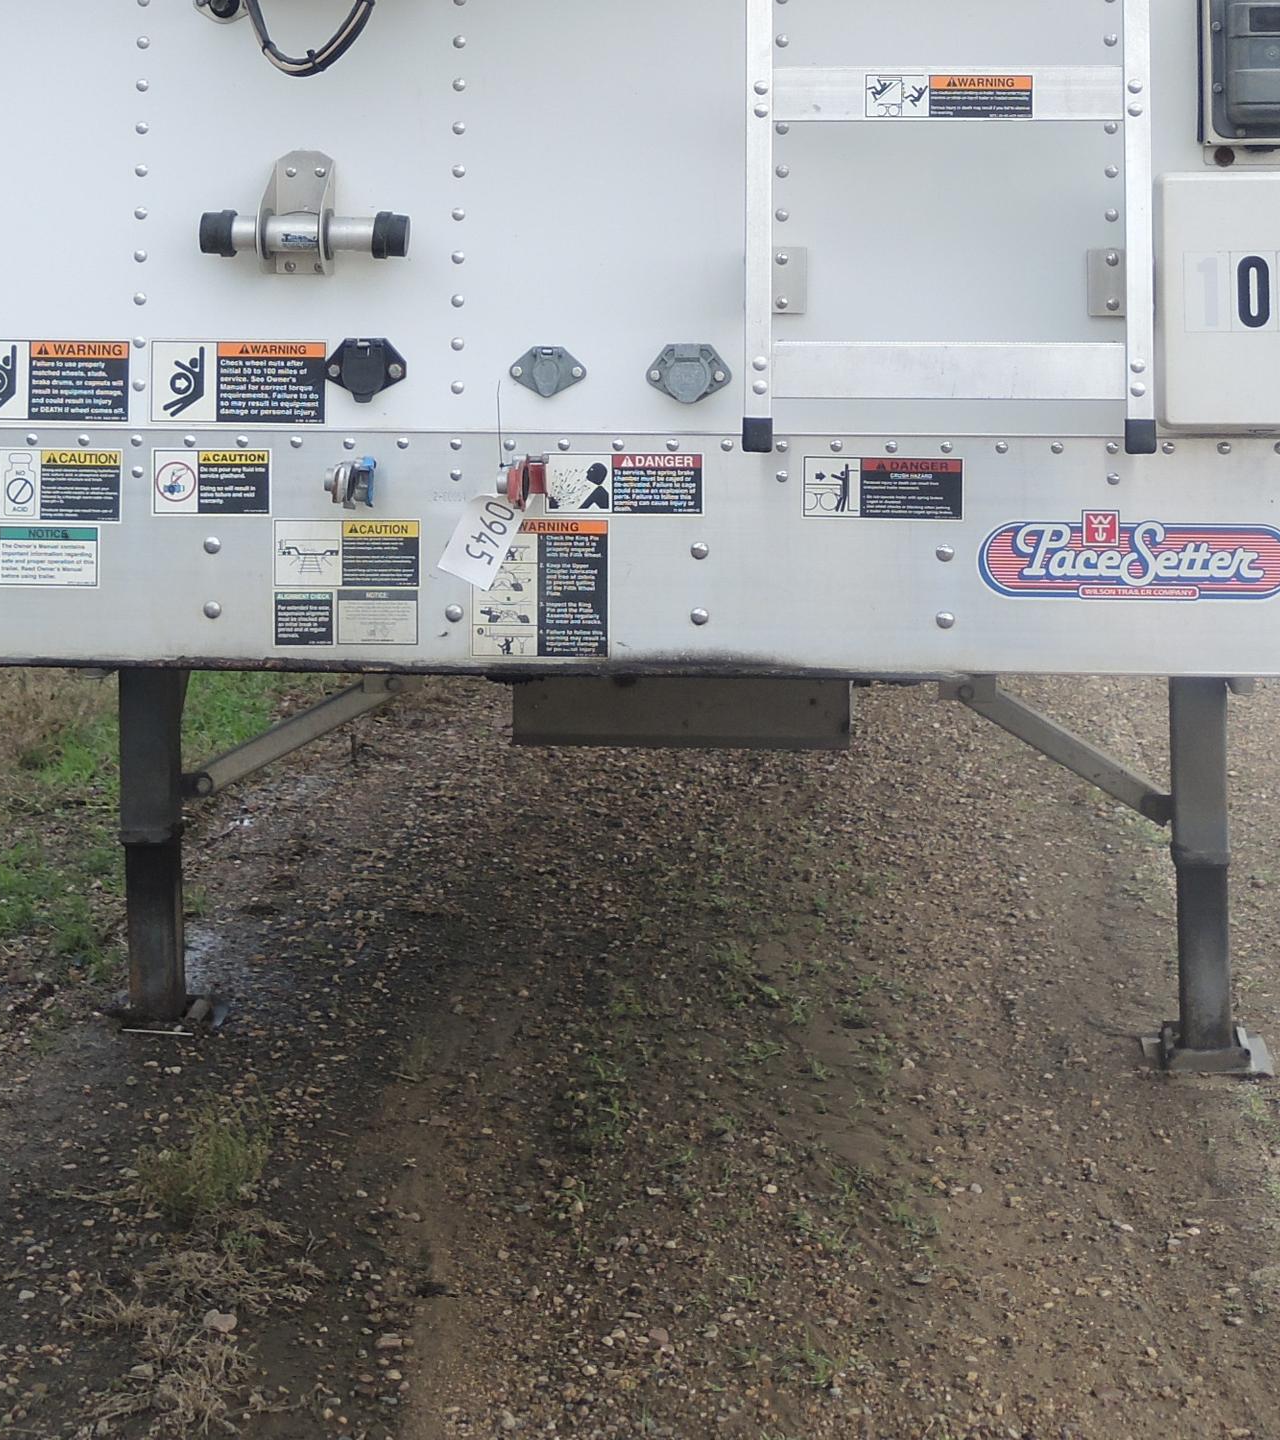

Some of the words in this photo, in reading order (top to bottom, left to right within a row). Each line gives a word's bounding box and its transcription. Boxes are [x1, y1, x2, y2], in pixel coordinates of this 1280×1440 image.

[958, 78, 1014, 88] WARNING
[54, 344, 123, 356] WARNING
[250, 345, 306, 355] WARNING
[77, 361, 105, 370] properly
[51, 379, 73, 387] drums,
[59, 389, 94, 397] equipment
[95, 389, 123, 397] damage,
[293, 409, 317, 417] injury.
[59, 453, 118, 464] CAUTION
[212, 454, 266, 462] CAUTION
[636, 456, 694, 467] DANGER
[890, 461, 949, 471] DANGER
[359, 524, 408, 534] CAUTION
[520, 522, 580, 532] WARNING
[28, 530, 68, 538] NOTICE
[466, 501, 515, 566] 0945
[1016, 522, 1264, 587] PaceSetter
[1154, 588, 1193, 596] COMPANY
